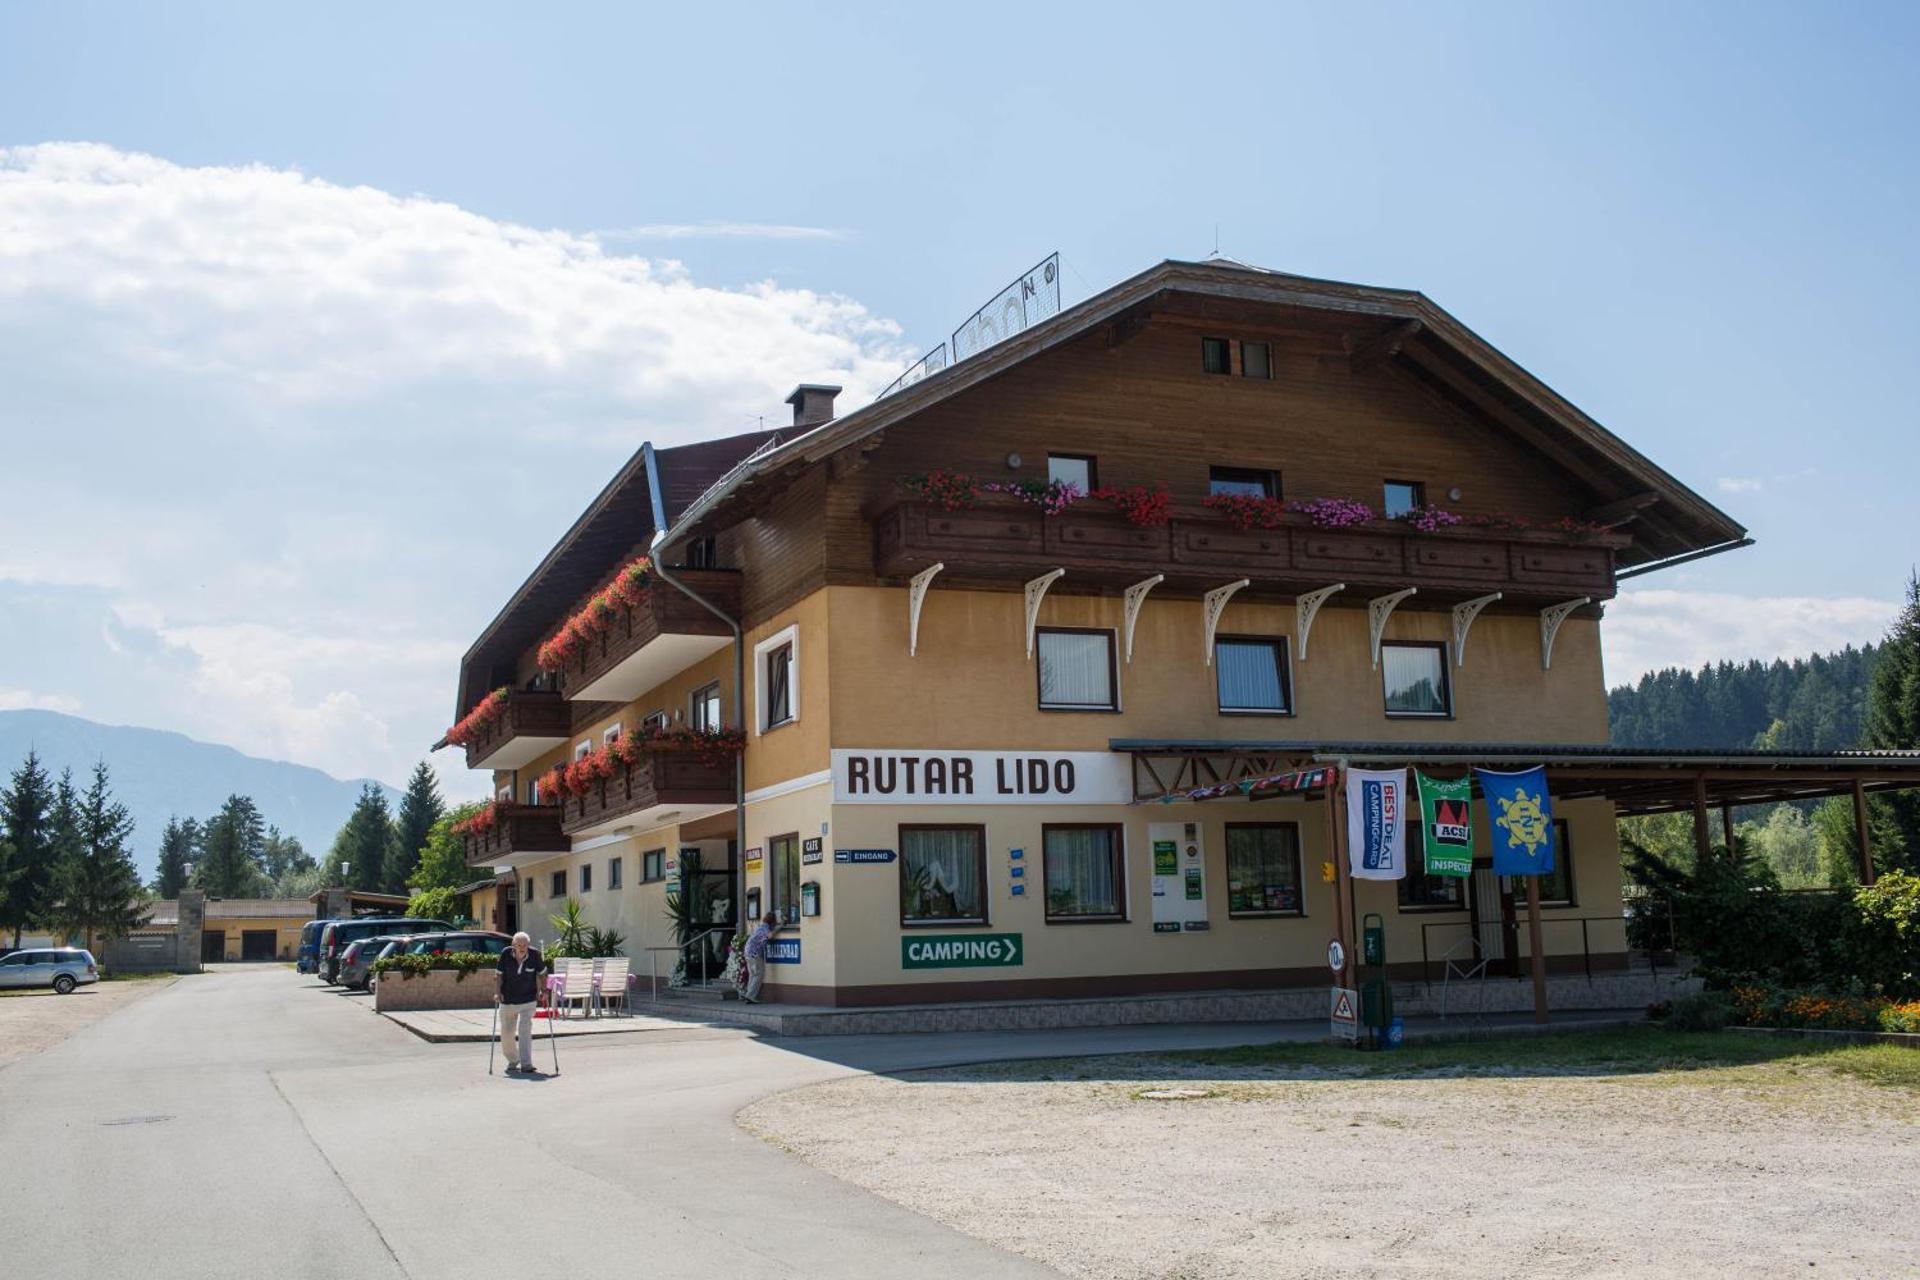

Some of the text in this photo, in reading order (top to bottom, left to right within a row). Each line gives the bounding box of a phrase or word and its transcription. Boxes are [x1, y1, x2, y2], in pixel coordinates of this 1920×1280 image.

[848, 757, 1075, 794] RUTAR LIDO
[1441, 826, 1466, 838] ACSI
[854, 852, 888, 860] EINGANG
[908, 940, 1002, 961] CAMPING
